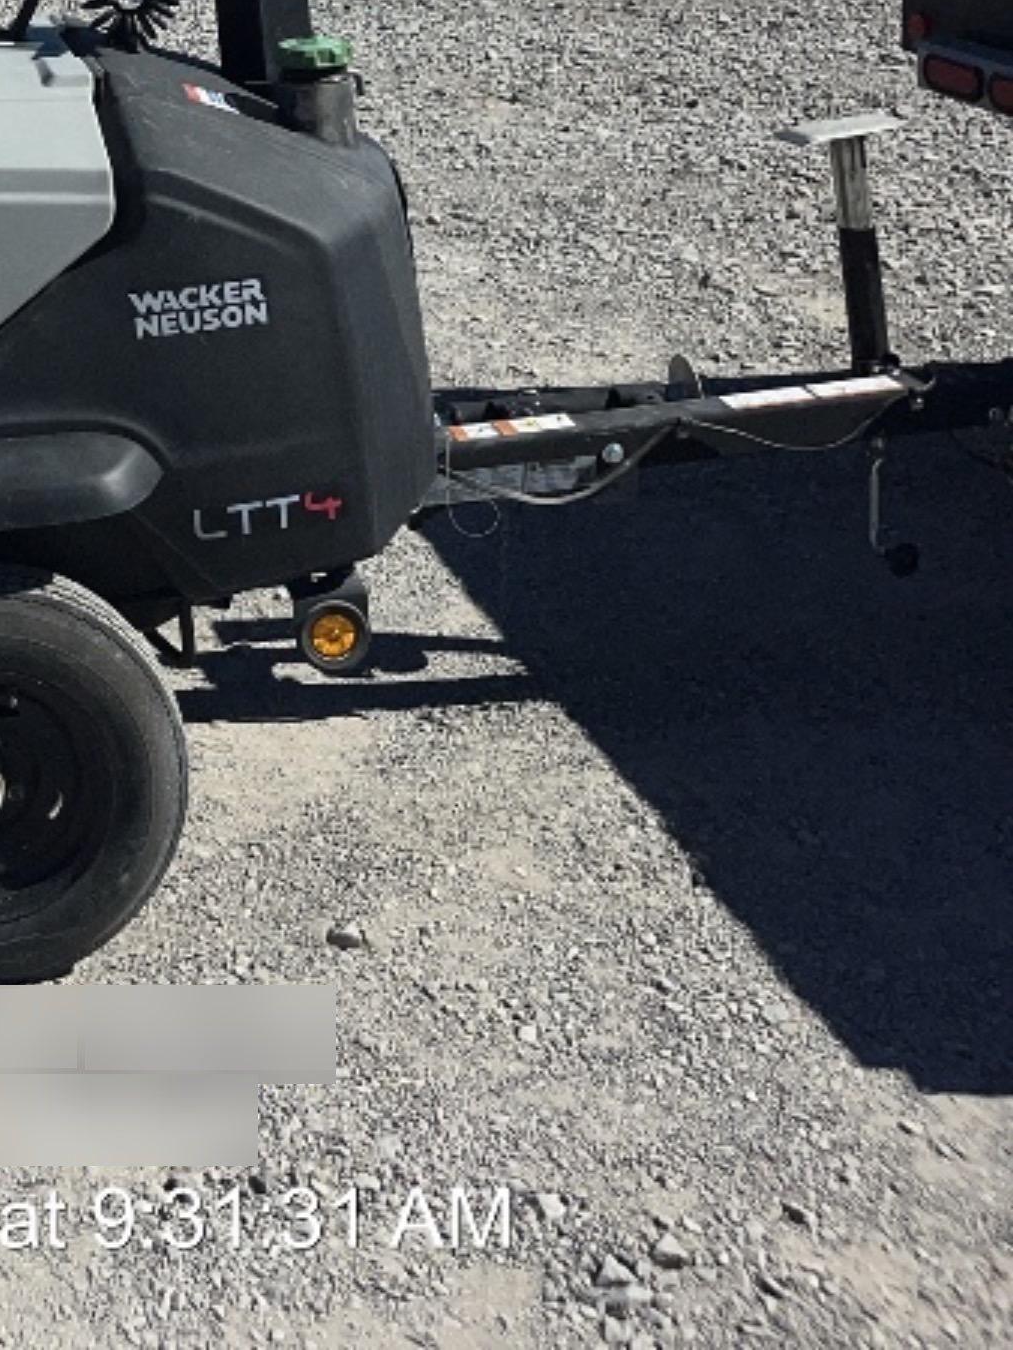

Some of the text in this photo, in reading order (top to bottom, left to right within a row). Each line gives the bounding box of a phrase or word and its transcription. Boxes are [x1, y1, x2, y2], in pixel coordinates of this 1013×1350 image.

[127, 278, 266, 315] WACKER
[134, 301, 268, 340] NEUSON
[193, 491, 342, 539] LTT4
